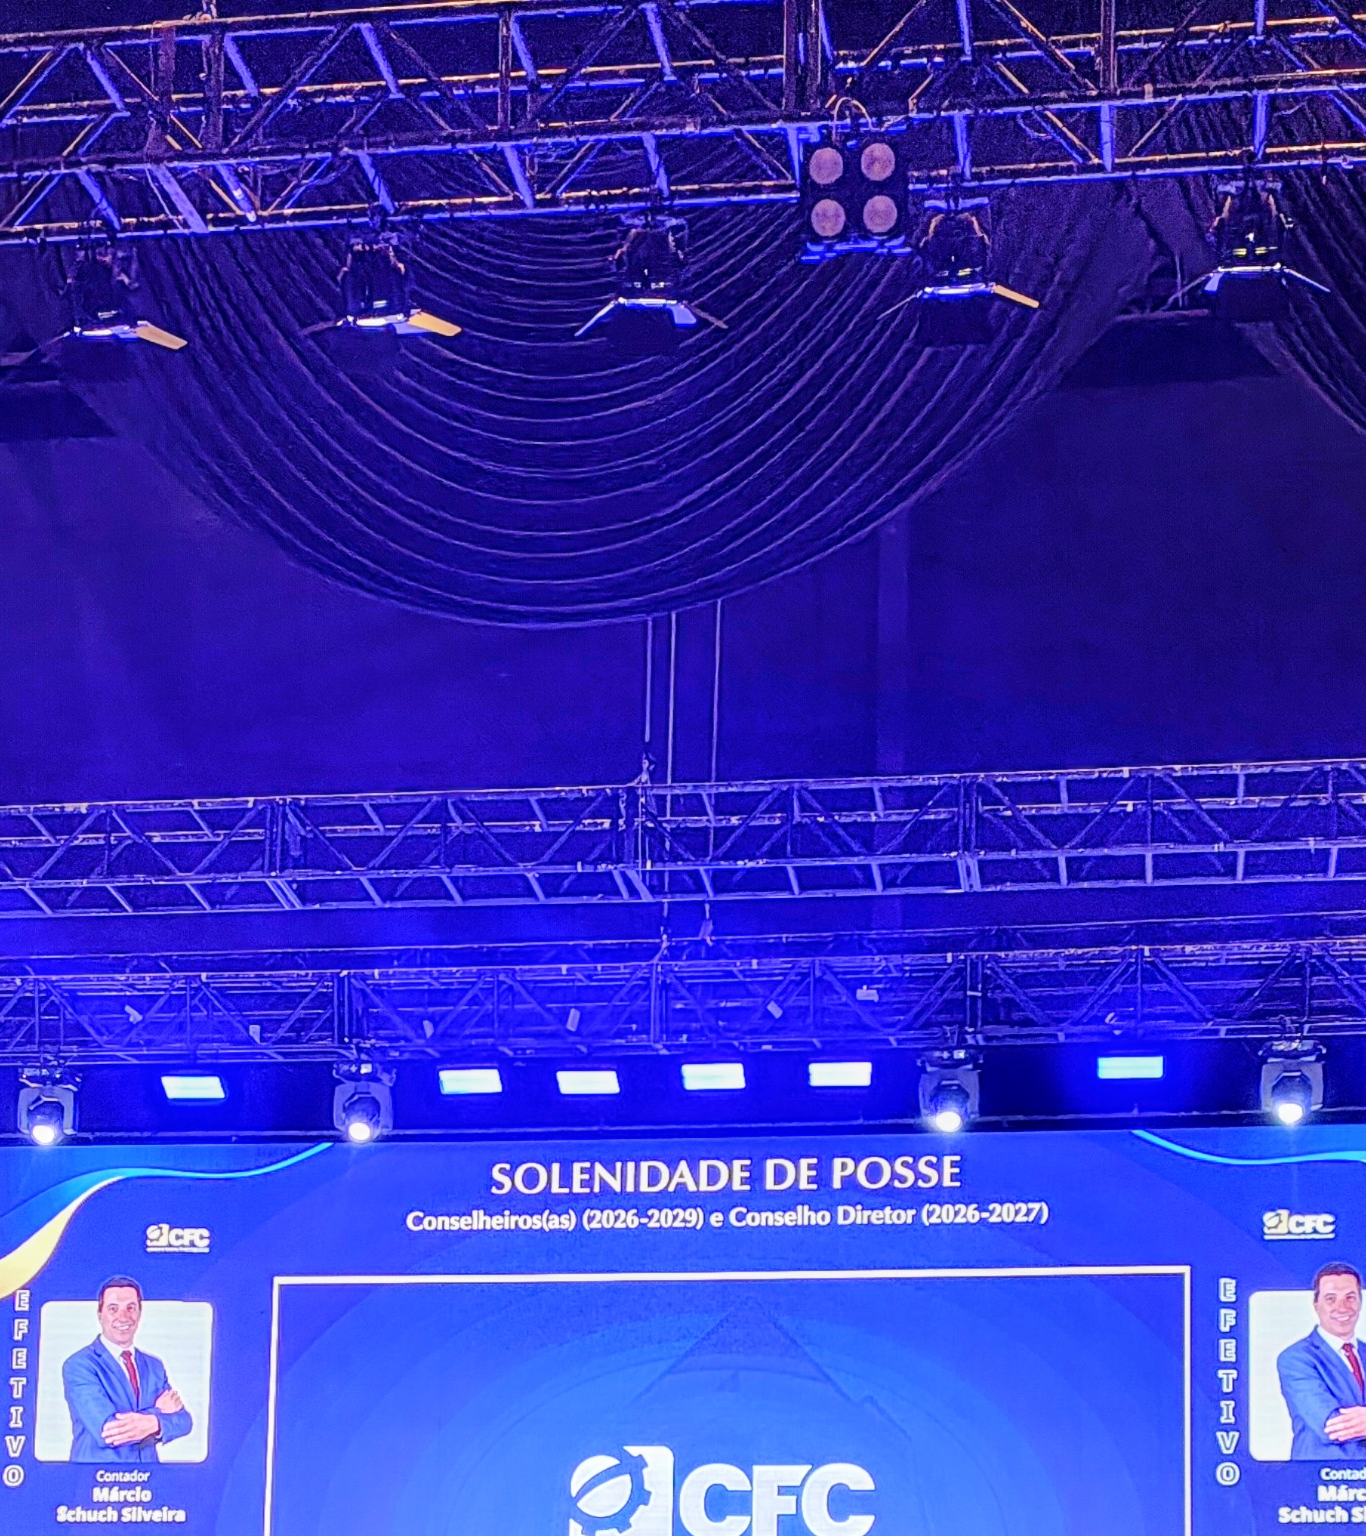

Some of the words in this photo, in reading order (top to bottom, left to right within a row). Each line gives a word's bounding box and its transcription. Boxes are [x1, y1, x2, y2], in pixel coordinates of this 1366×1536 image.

[490, 1158, 752, 1195] SOLENIDADE
[764, 1157, 819, 1192] DE
[831, 1154, 962, 1190] POSSE
[405, 1208, 577, 1232] Conselheiros(as)
[582, 1206, 705, 1231] (2026-2029)
[709, 1212, 724, 1228] e
[728, 1204, 832, 1227] Conselho
[836, 1203, 917, 1226] Diretor
[921, 1201, 1050, 1226] (2026-2027)
[1288, 1212, 1336, 1234] CFC
[168, 1227, 211, 1248] CFC
[2, 1289, 31, 1488] EFETIVO
[1215, 1277, 1241, 1487] EFETIVO
[95, 1469, 151, 1483] Contador
[92, 1486, 153, 1503] Márcio
[56, 1505, 119, 1523] Schuch
[121, 1506, 187, 1523] Silveira
[1278, 1504, 1349, 1524] Schuch
